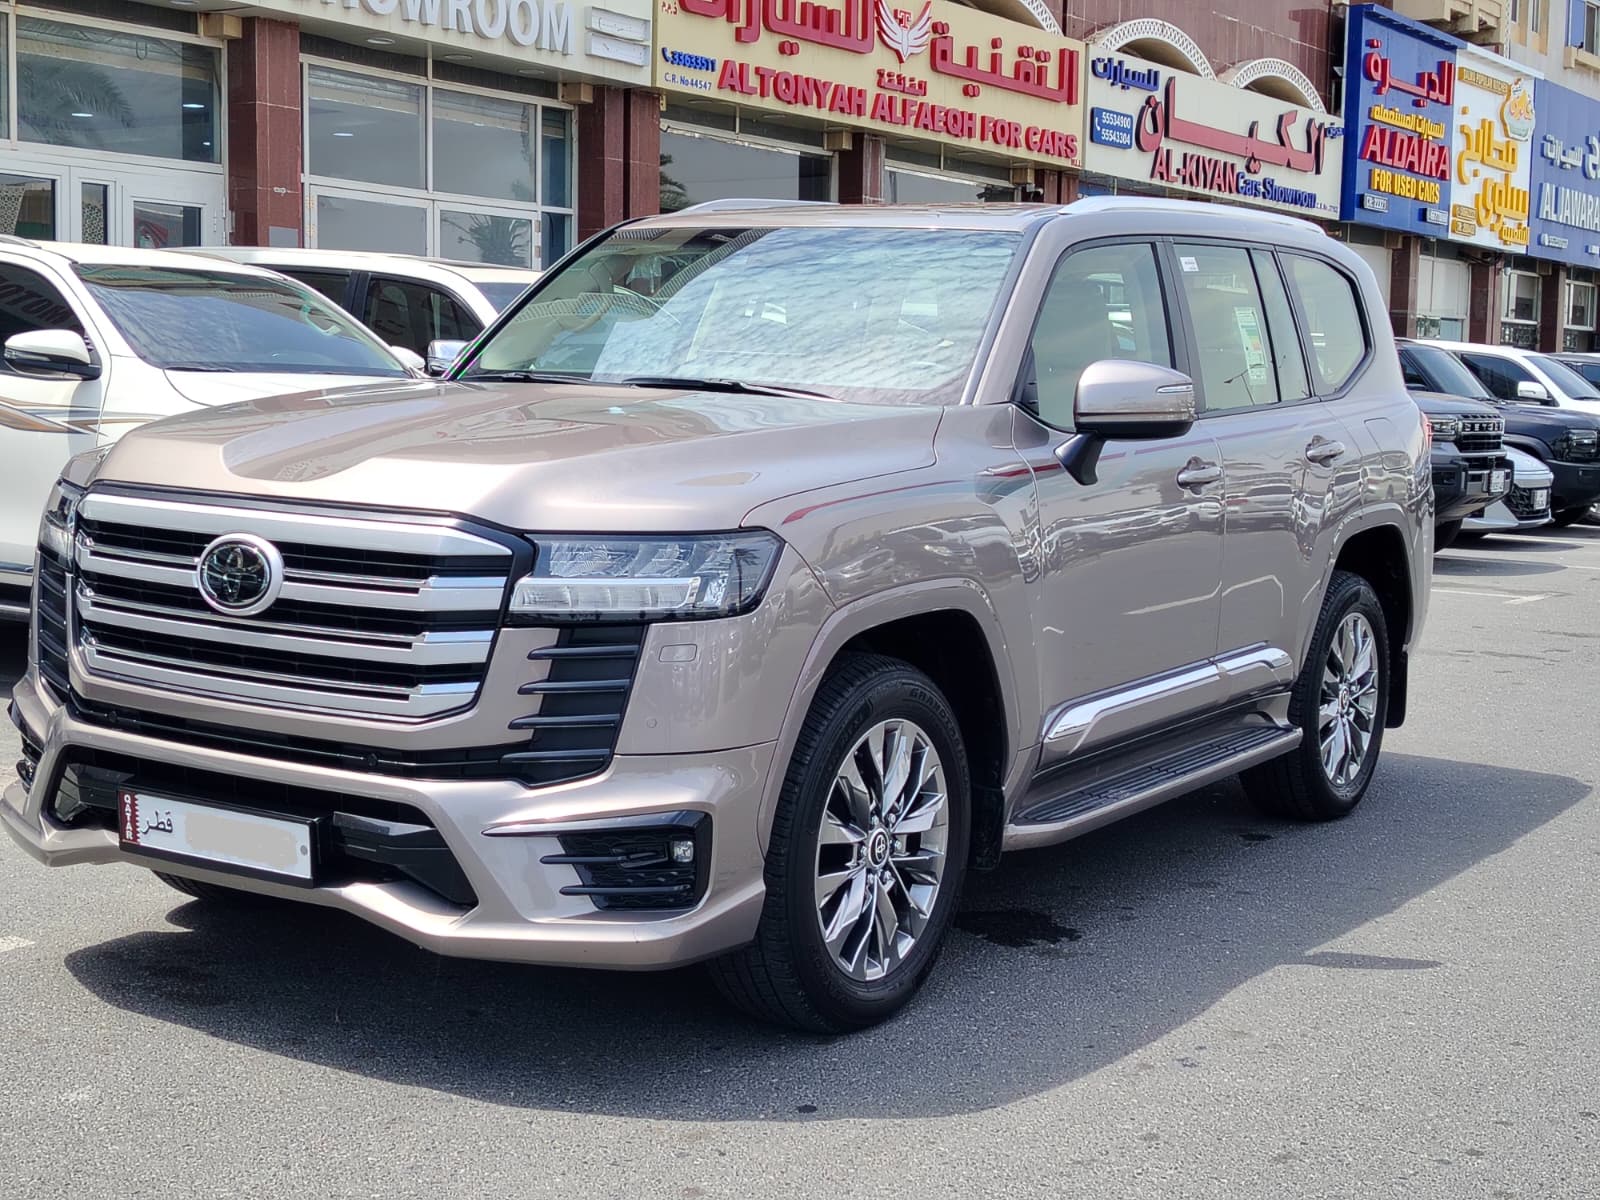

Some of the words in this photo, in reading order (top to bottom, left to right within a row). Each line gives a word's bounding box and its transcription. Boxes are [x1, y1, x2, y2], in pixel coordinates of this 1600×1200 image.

[320, 0, 576, 55] WROOM
[930, 21, 1079, 105] التقنية
[1091, 57, 1160, 91] للسيارات
[1364, 38, 1455, 108] الديرة
[717, 59, 867, 117] ALTQNYAH
[871, 93, 977, 139] ALFAEQH
[980, 115, 1022, 148] FOR
[1025, 126, 1078, 159] CARS
[1135, 76, 1326, 175] الكيان
[1151, 147, 1238, 194] AL-KIYAN
[1236, 171, 1262, 196] Cars
[1360, 124, 1449, 180] ALDAIRA
[1369, 168, 1392, 193] FOR
[1393, 172, 1417, 199] USED
[1417, 178, 1440, 204] CARS
[123, 793, 134, 841] QATAR
[141, 811, 174, 835] قطر
